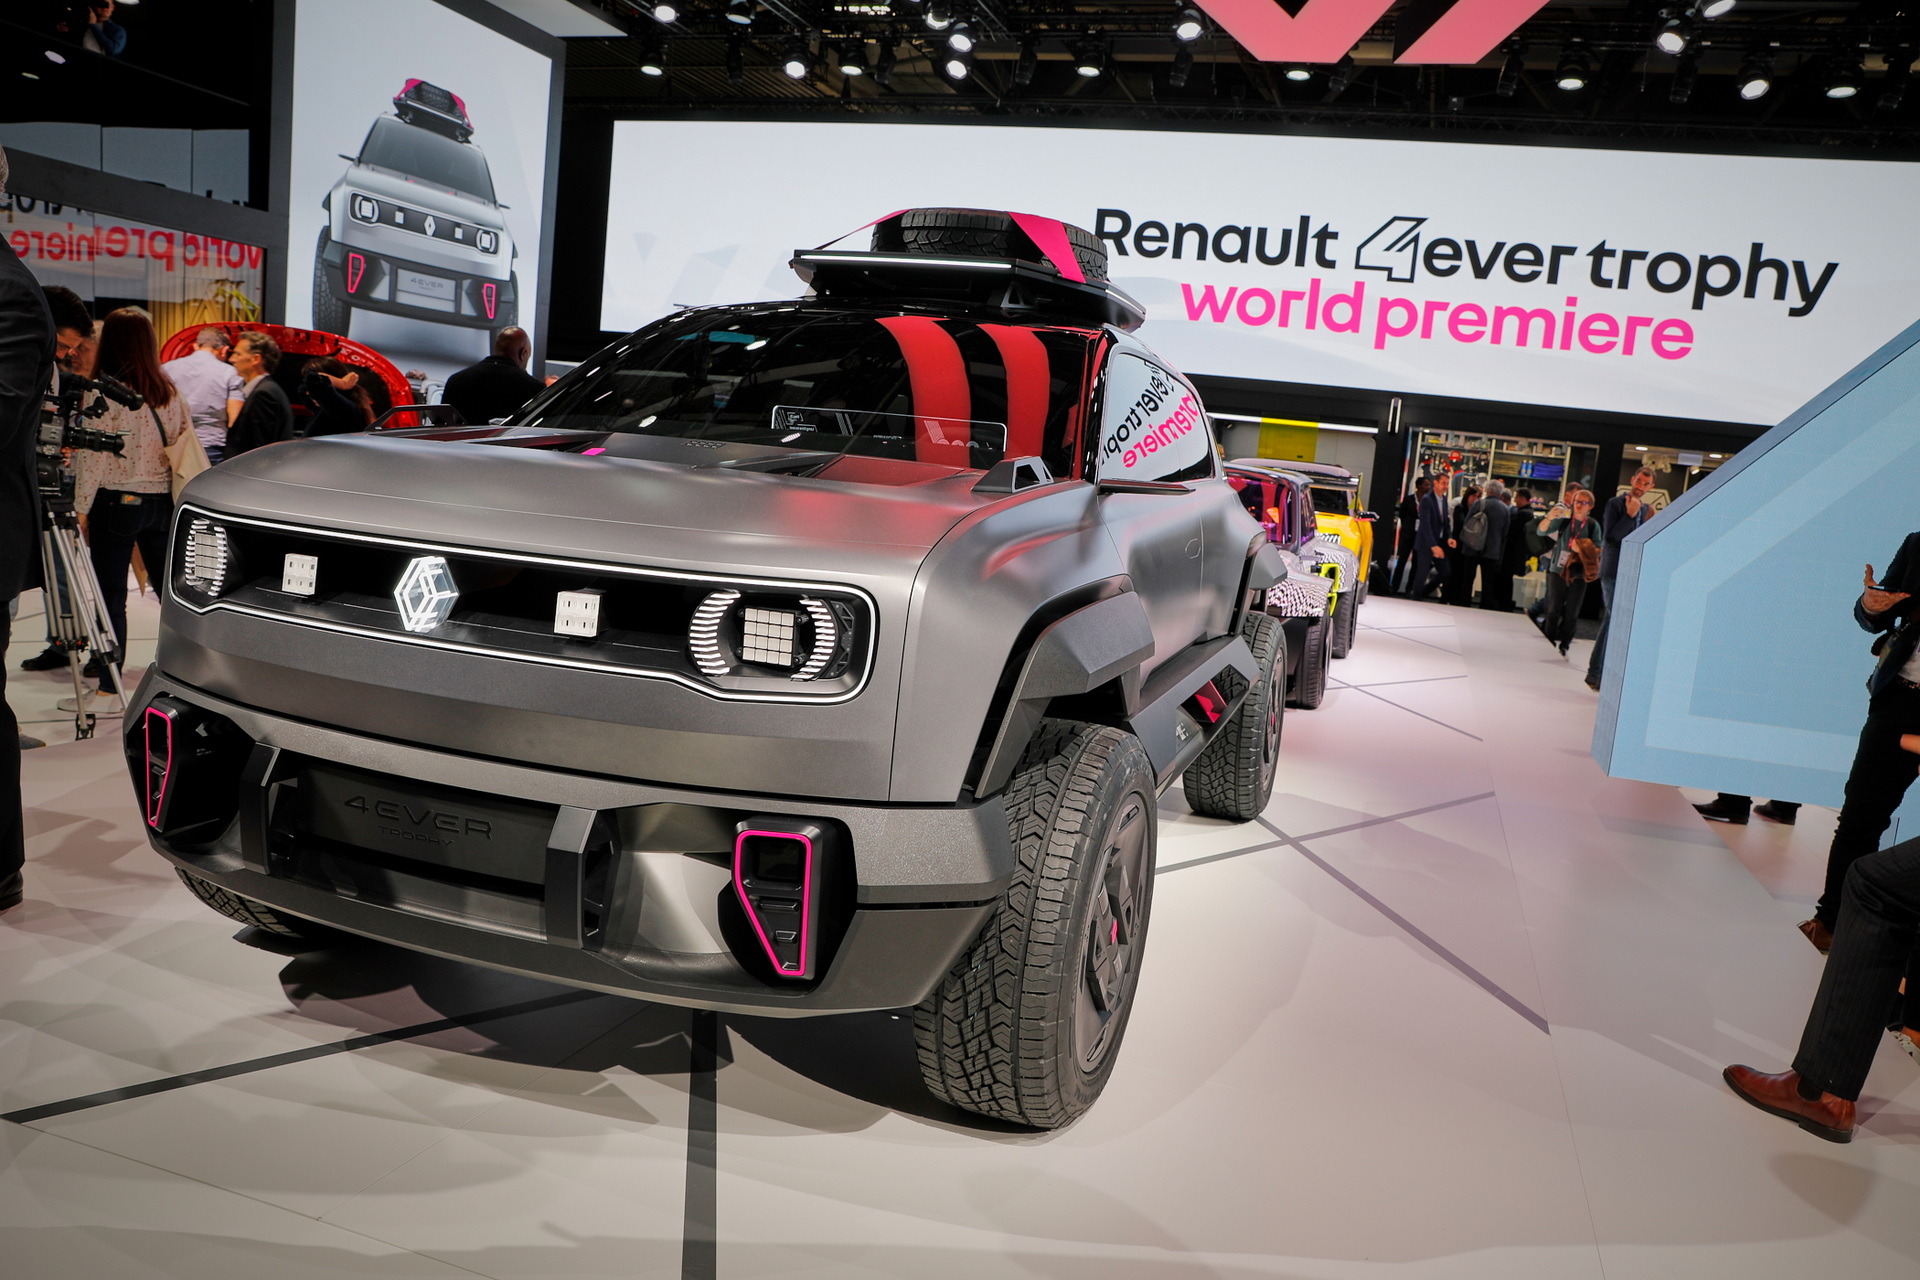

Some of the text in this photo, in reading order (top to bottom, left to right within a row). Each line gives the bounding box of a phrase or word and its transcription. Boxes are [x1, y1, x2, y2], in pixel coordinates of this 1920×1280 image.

[1095, 208, 1338, 269] Renault
[1587, 240, 1840, 318] trophy
[1181, 278, 1695, 361] world premiere
[344, 795, 493, 841] 4EVER
[377, 825, 453, 848] TROPHY
